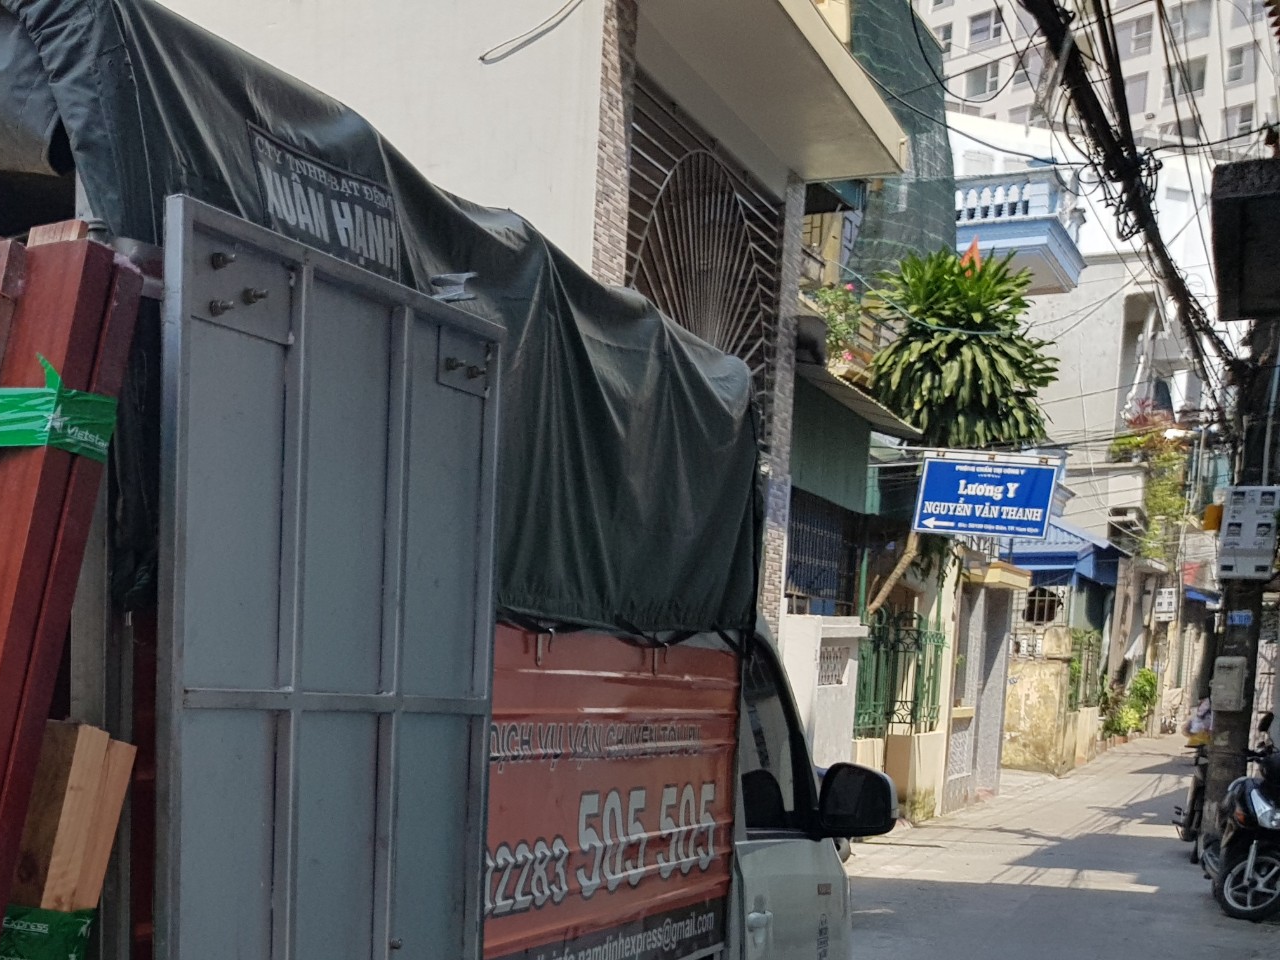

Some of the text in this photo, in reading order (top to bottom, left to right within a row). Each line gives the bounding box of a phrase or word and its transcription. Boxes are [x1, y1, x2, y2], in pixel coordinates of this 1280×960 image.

[258, 161, 398, 272] XUÂN HẠNH
[958, 479, 1020, 500] Lương Y
[974, 502, 1000, 518] VĂN
[1000, 507, 1043, 522] THANH
[538, 722, 563, 772] VỤ
[567, 719, 604, 771] VẬN
[2, 917, 48, 933] Express
